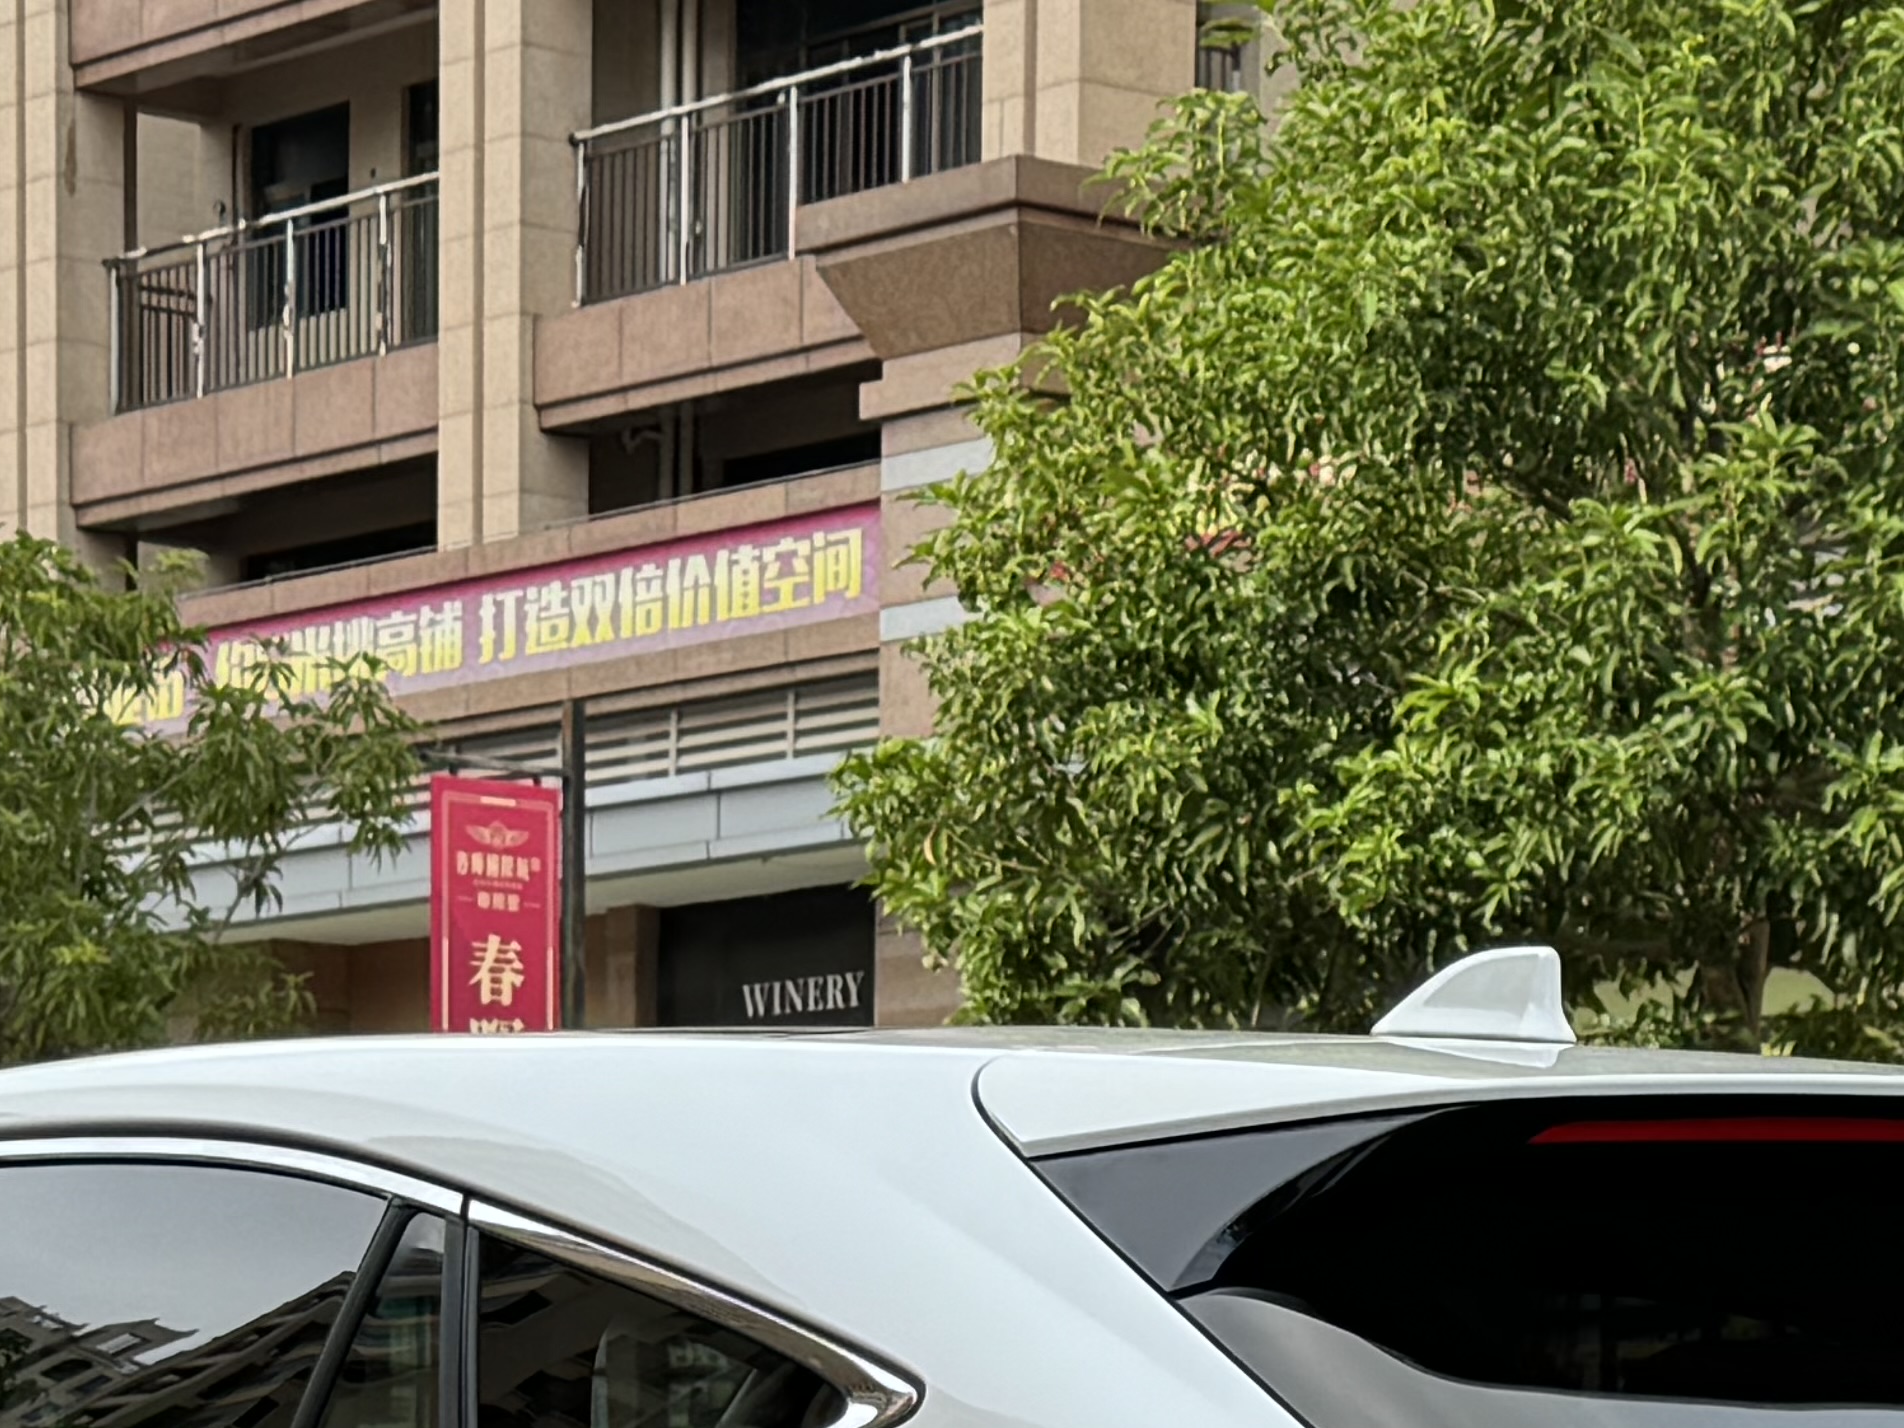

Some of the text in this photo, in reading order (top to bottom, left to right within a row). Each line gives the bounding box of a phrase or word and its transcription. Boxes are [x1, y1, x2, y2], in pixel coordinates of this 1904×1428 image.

[479, 528, 863, 665] 打造双倍价值空间
[742, 971, 864, 1018] WINERY
